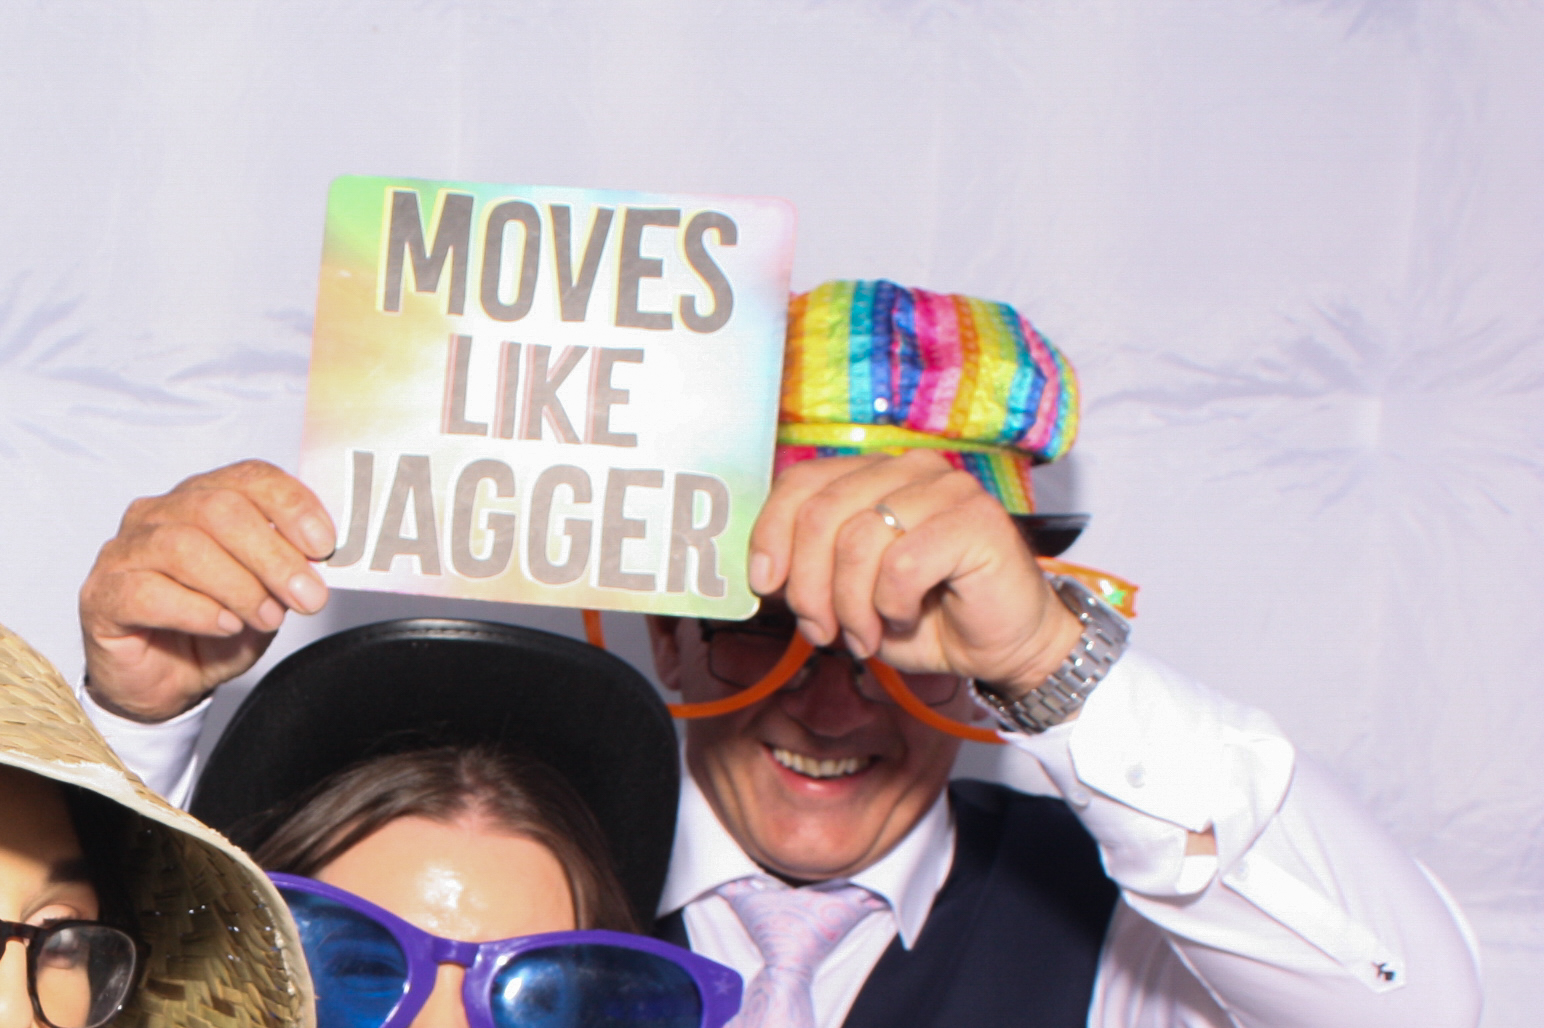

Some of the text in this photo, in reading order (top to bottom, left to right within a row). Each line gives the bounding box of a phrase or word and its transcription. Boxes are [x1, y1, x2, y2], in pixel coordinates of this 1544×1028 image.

[379, 187, 738, 334] MOVES
[440, 333, 644, 448] LIKE
[327, 450, 731, 598] JAGGER
